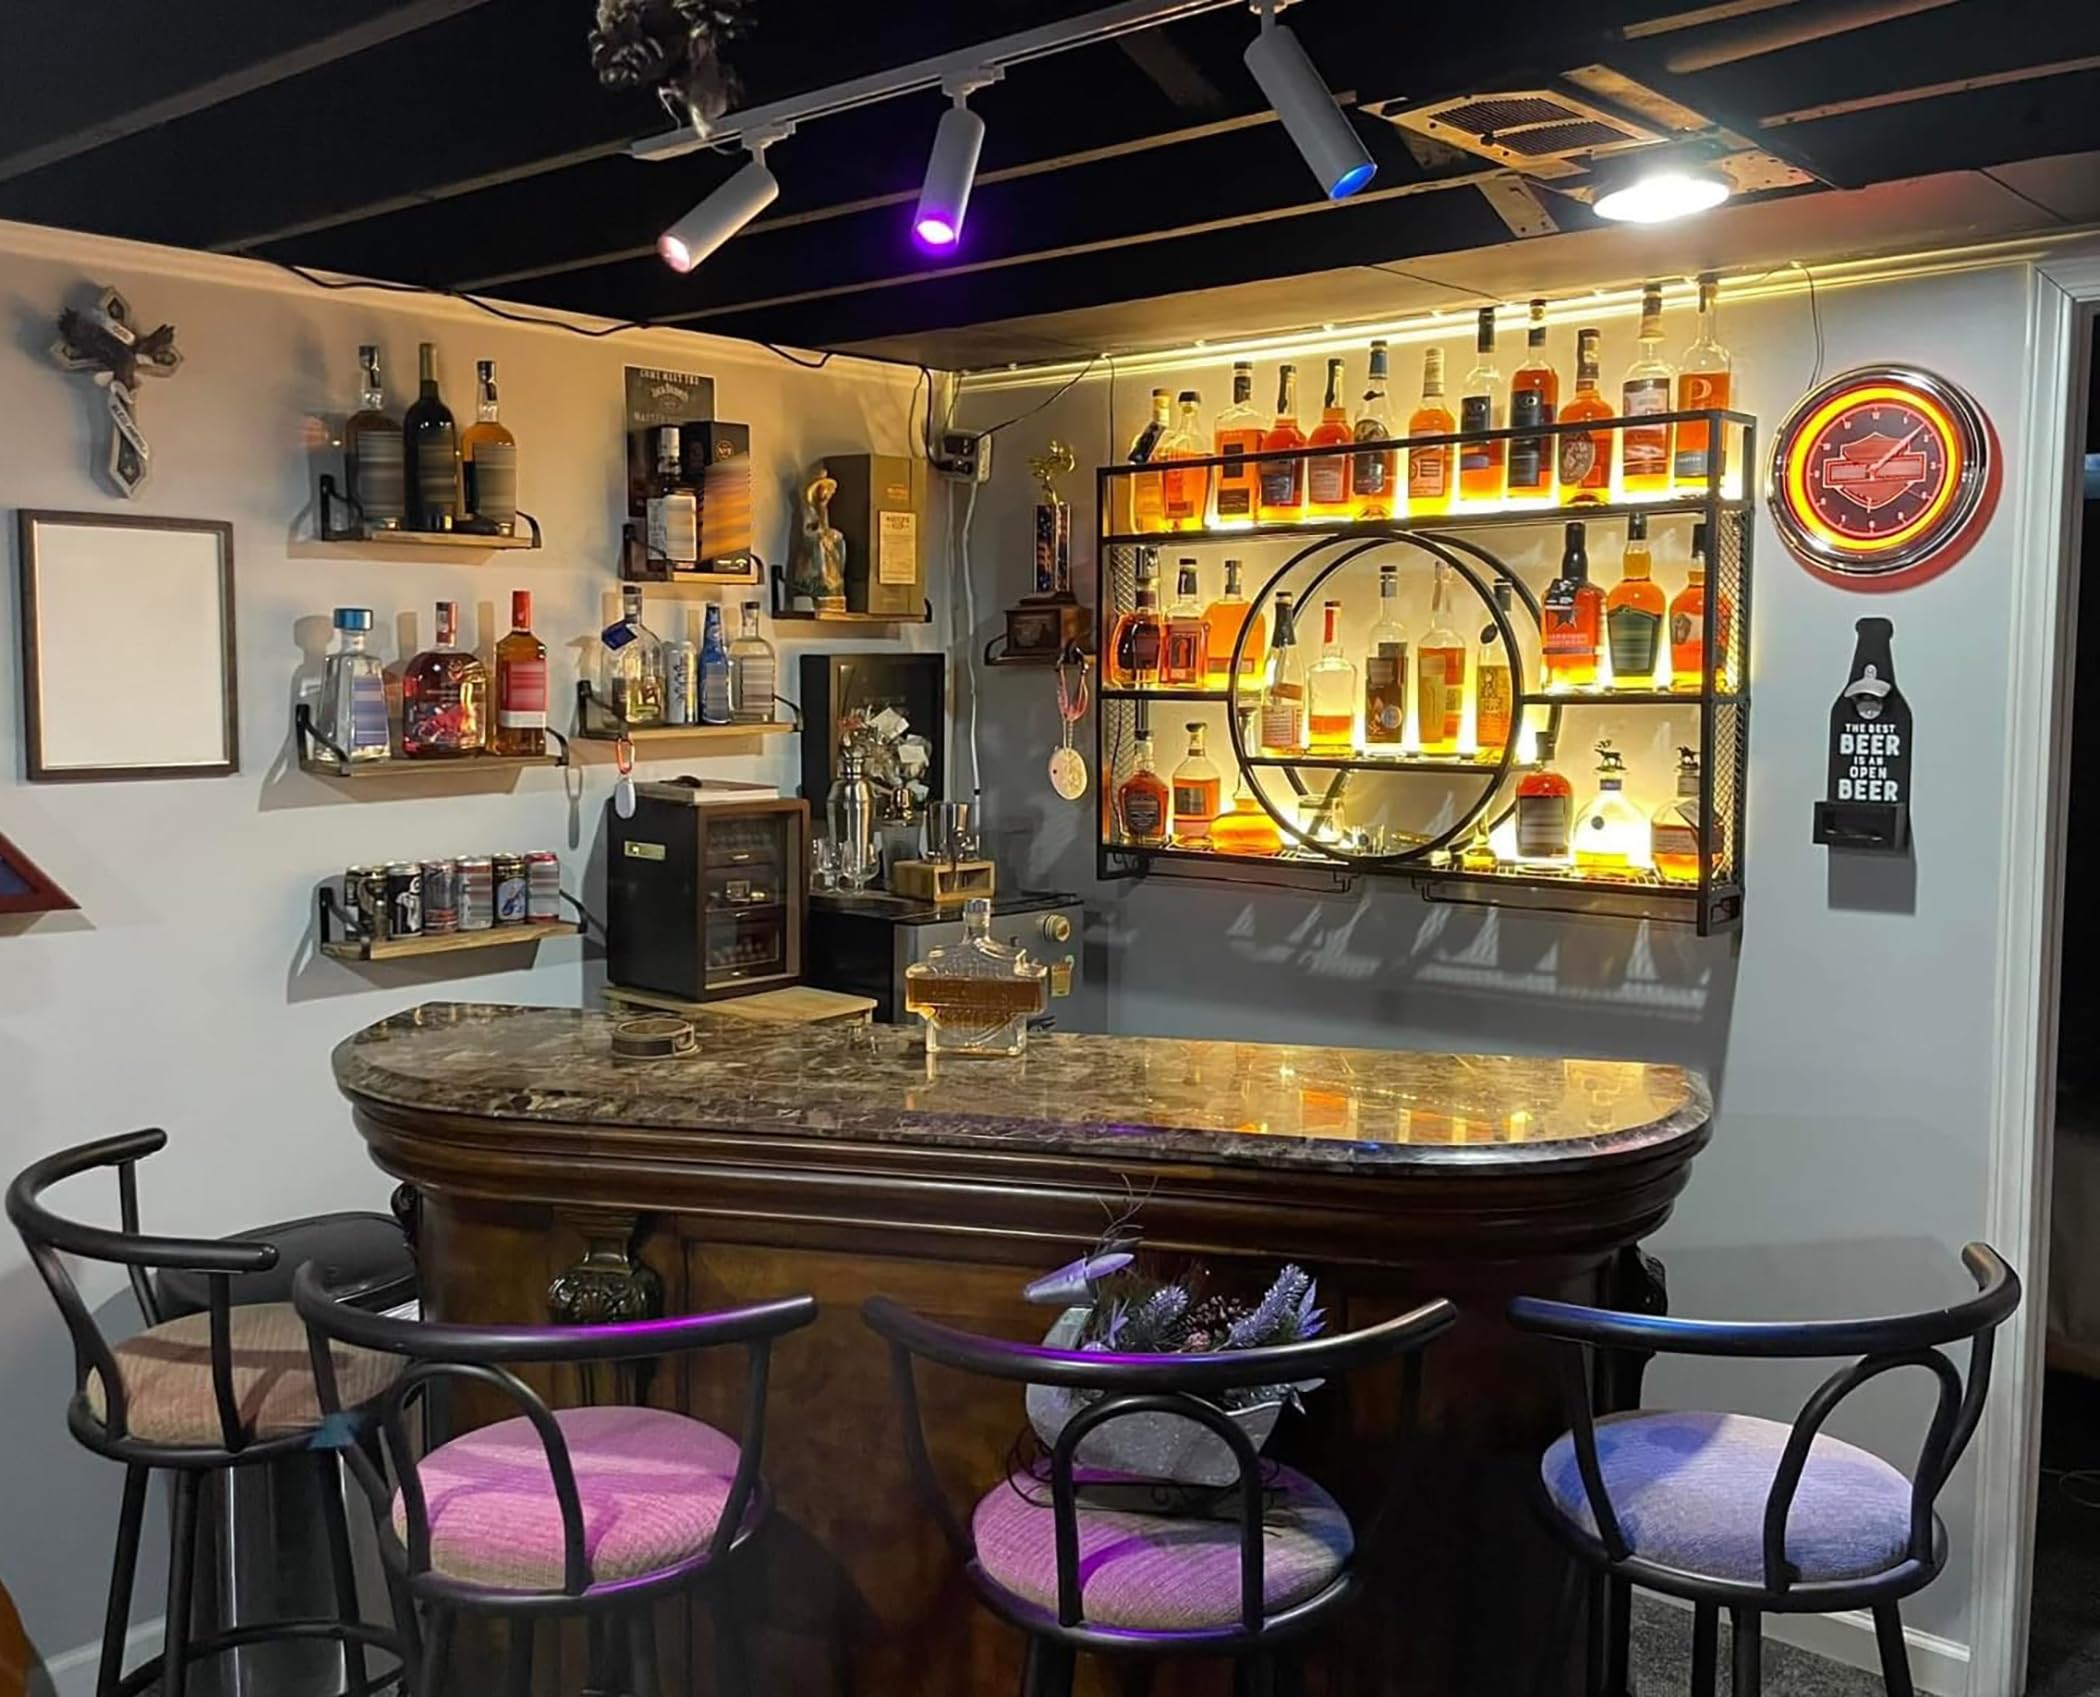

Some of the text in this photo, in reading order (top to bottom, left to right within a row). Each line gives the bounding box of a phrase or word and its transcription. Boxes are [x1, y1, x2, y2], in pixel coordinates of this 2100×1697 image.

[1845, 723, 1896, 734] THE BEST
[1840, 733, 1900, 756] BEER
[1854, 755, 1884, 766] IS AN
[1849, 766, 1887, 779] OPEN
[1838, 778, 1898, 802] BEER
